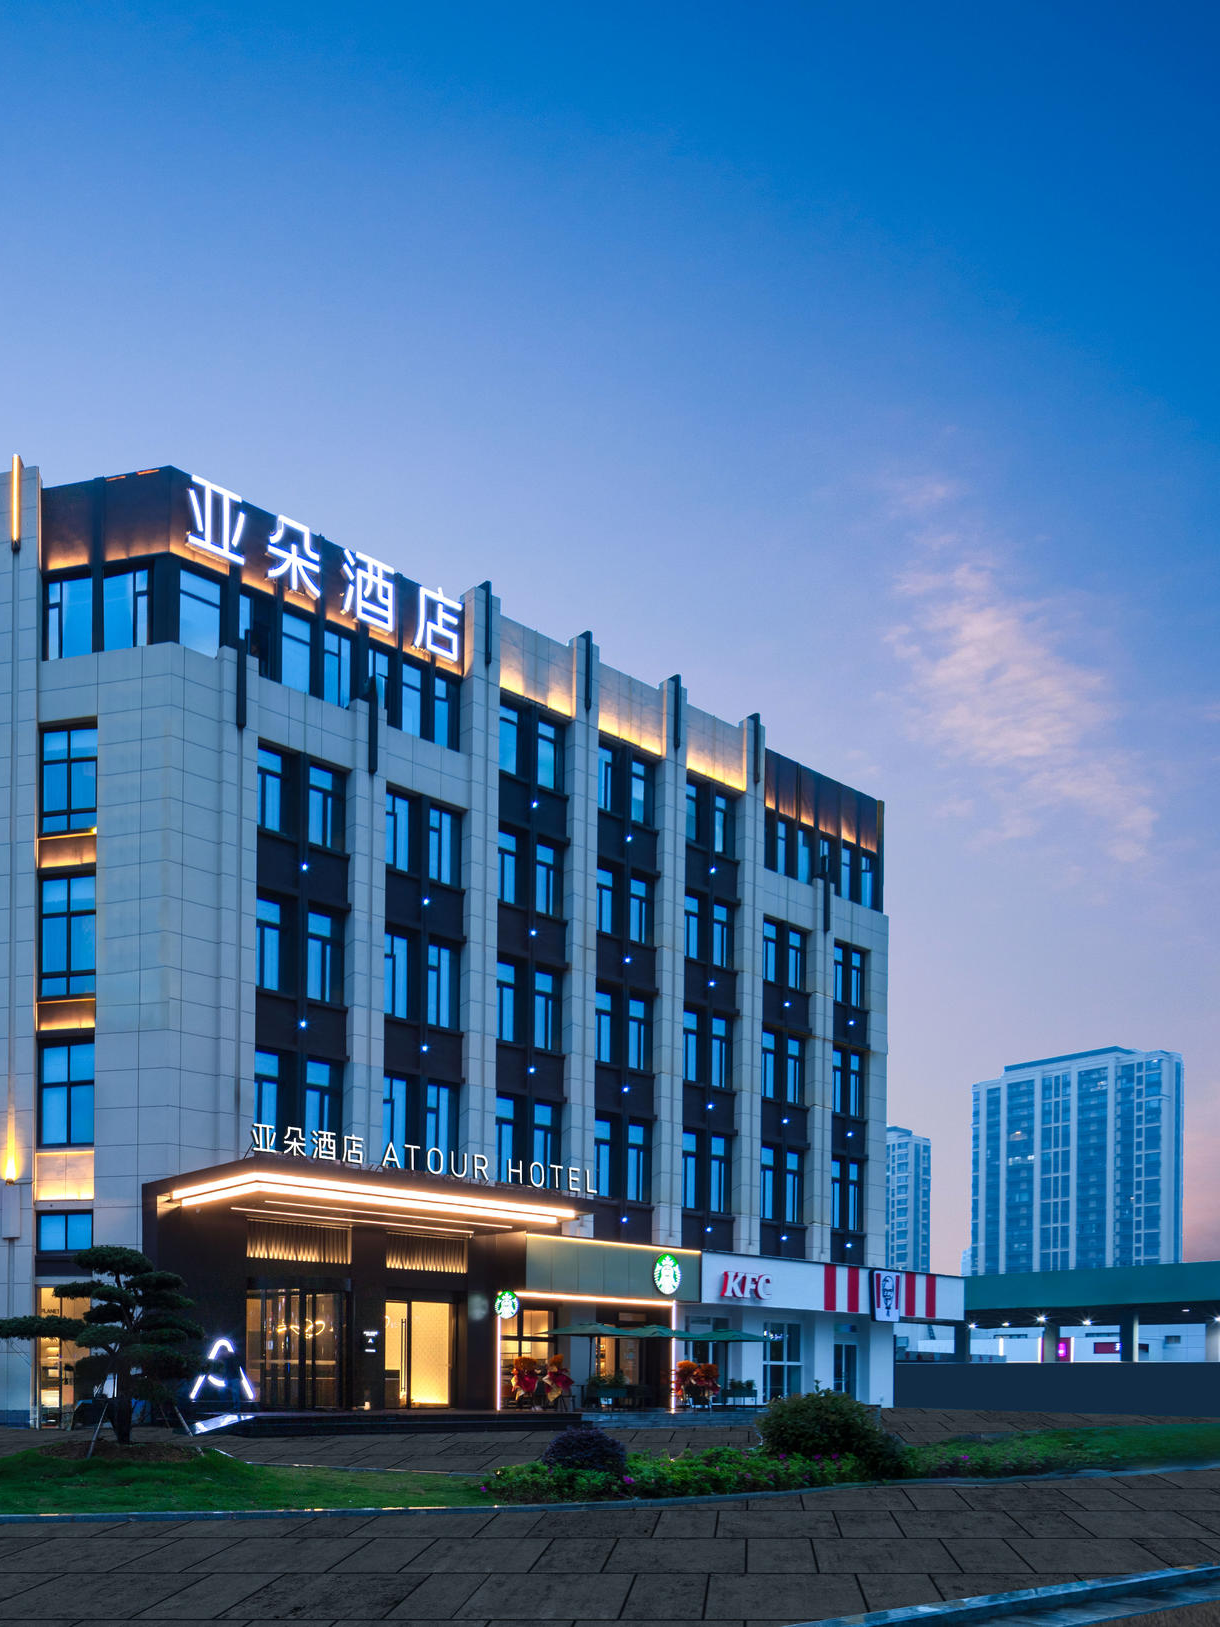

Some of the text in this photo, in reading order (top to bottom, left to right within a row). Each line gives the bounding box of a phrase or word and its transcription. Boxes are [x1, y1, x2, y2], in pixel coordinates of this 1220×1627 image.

[186, 474, 463, 662] 亚朵酒店
[251, 1123, 598, 1194] 亚朵酒店 ATOUR HOTEL
[720, 1270, 773, 1300] KFC
